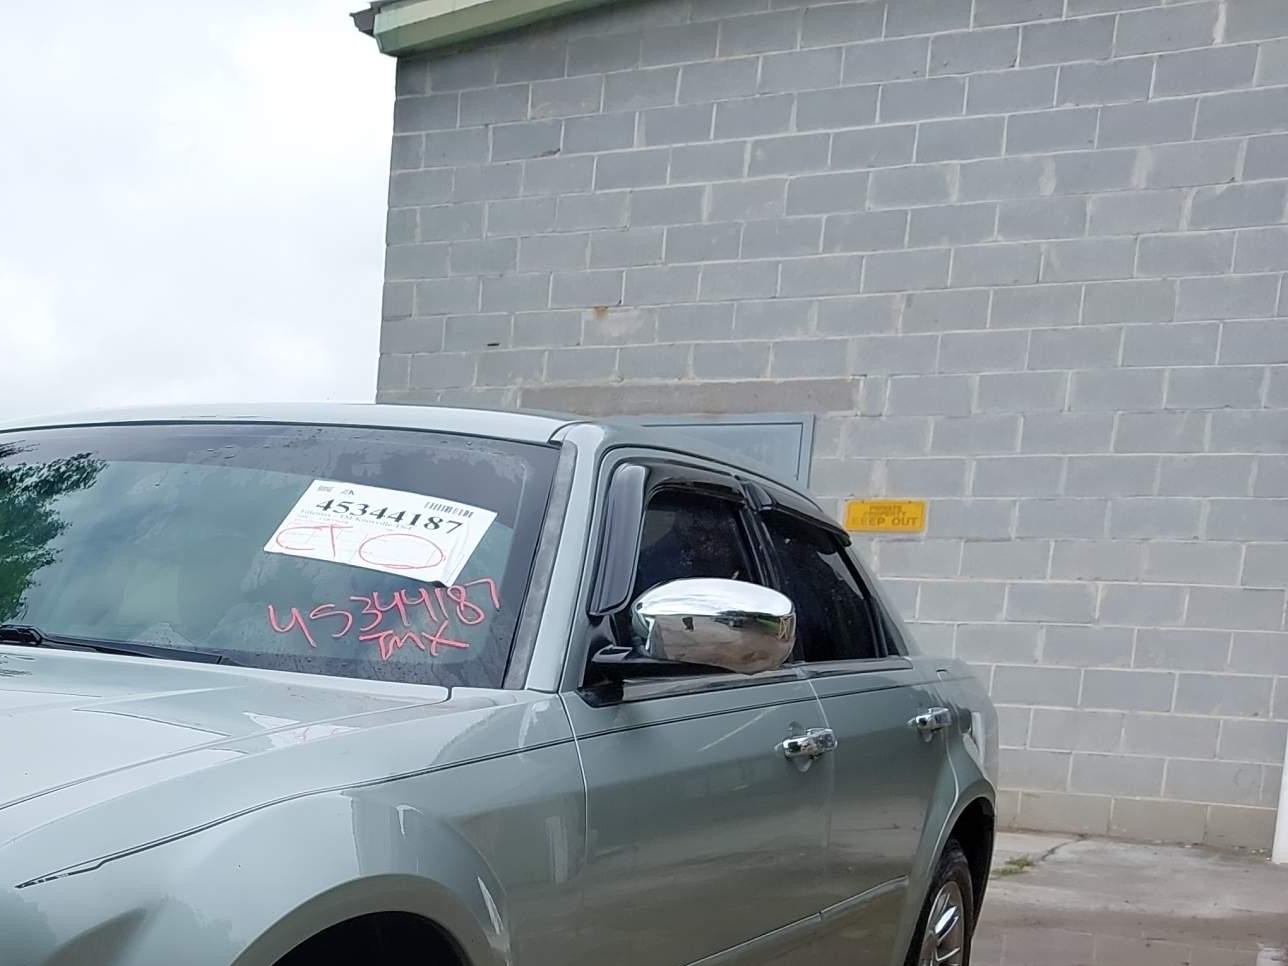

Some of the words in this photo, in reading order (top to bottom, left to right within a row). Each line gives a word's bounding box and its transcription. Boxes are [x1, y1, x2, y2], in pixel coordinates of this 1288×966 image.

[315, 498, 464, 535] 45344187
[852, 516, 886, 526] EEP
[891, 516, 919, 526] OUT
[267, 576, 501, 649] 45344187
